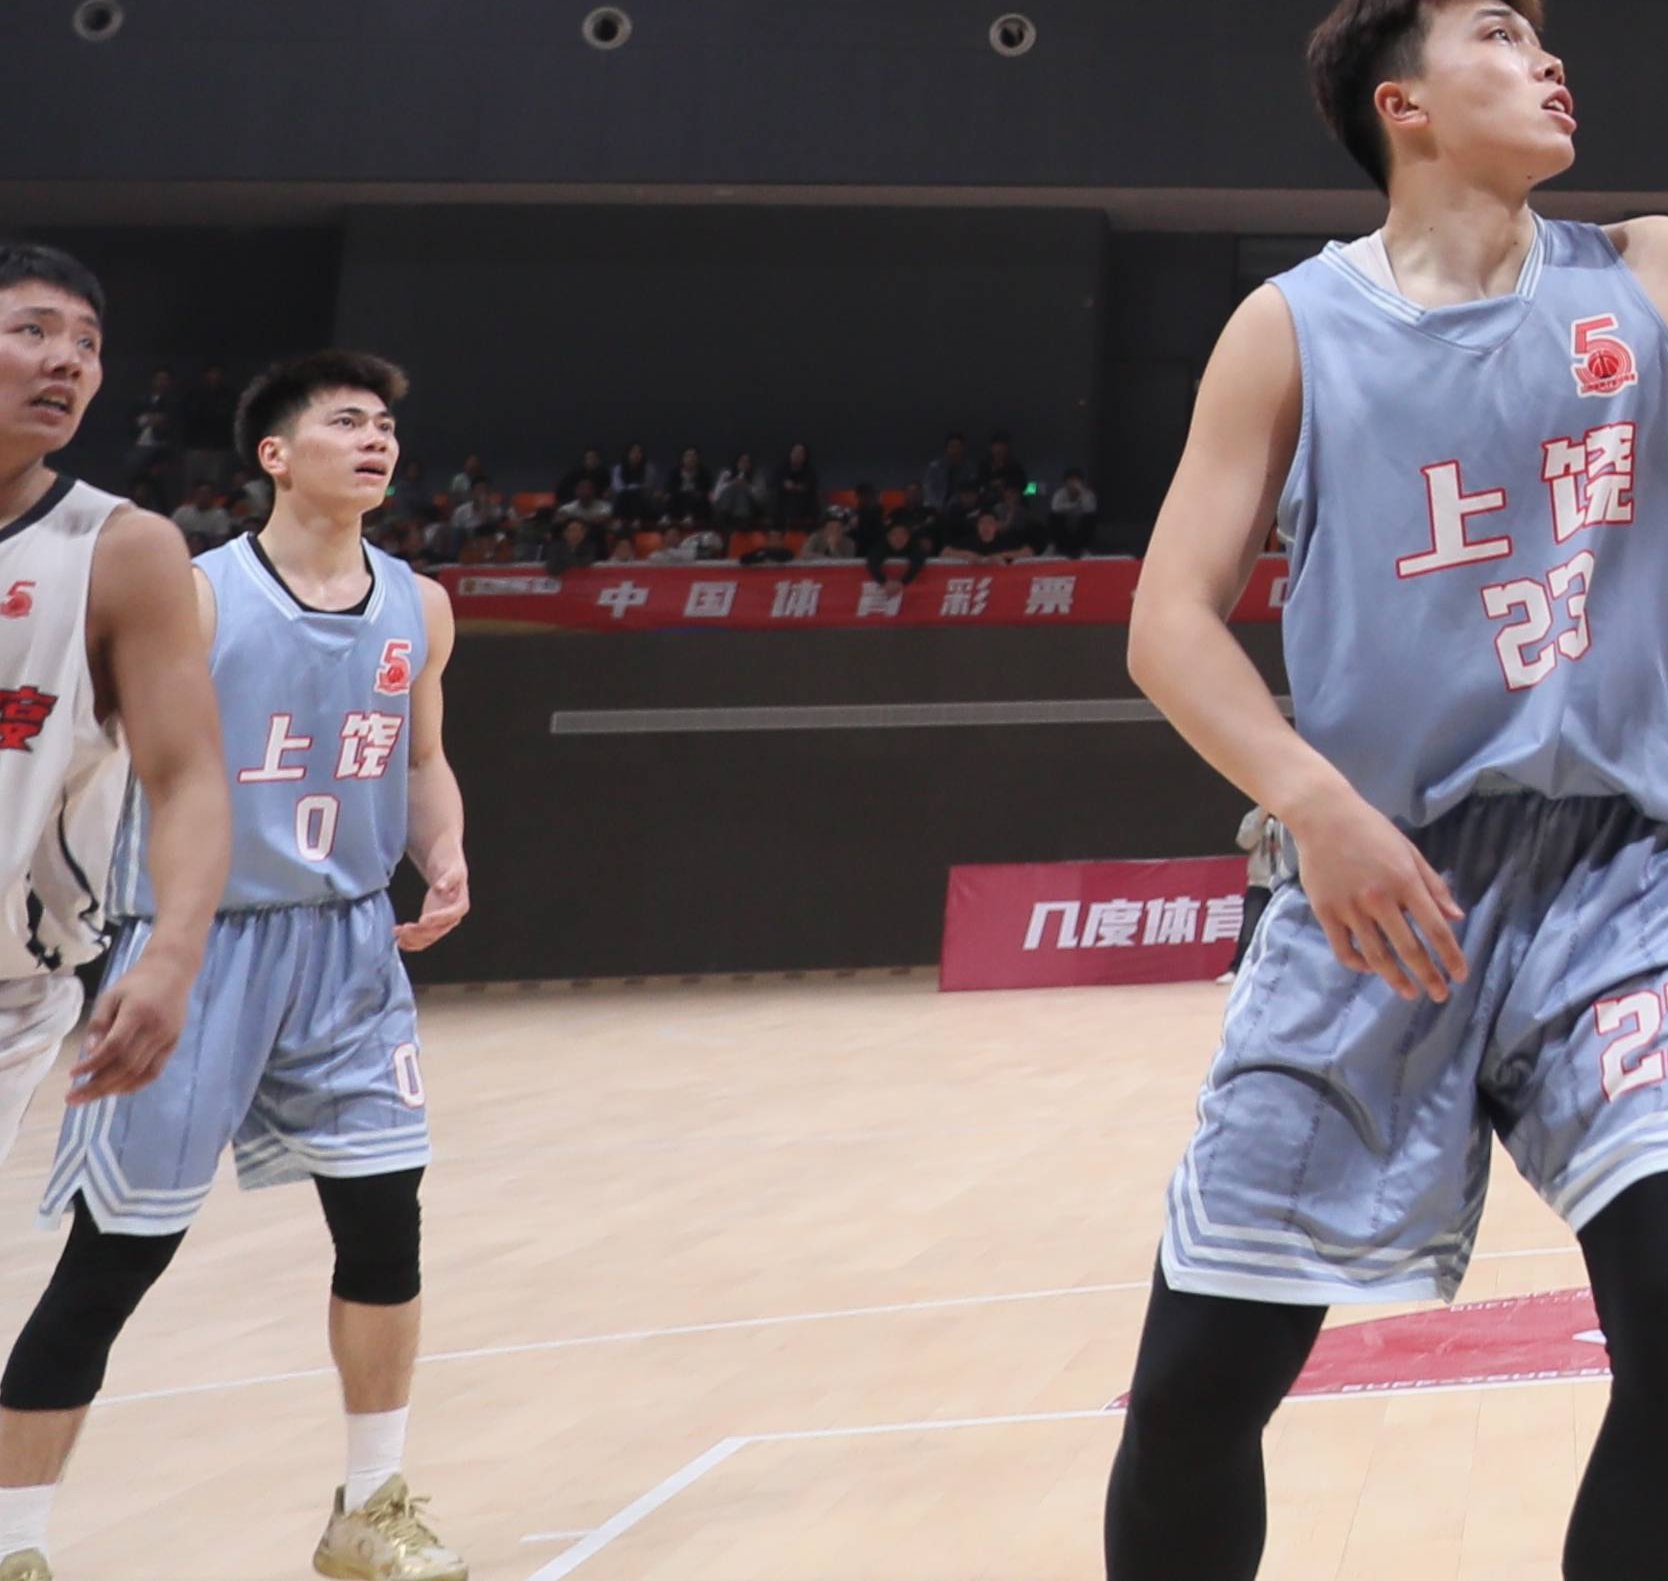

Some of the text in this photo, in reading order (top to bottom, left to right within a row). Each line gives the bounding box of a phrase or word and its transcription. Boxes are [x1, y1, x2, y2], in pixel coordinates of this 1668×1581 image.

[1396, 422, 1637, 580] 上饶
[597, 576, 1078, 618] 中国体育彩票
[1483, 550, 1596, 691] 23
[238, 712, 403, 784] 上饶
[294, 793, 340, 862] 0
[1022, 895, 1245, 952] 几度体育
